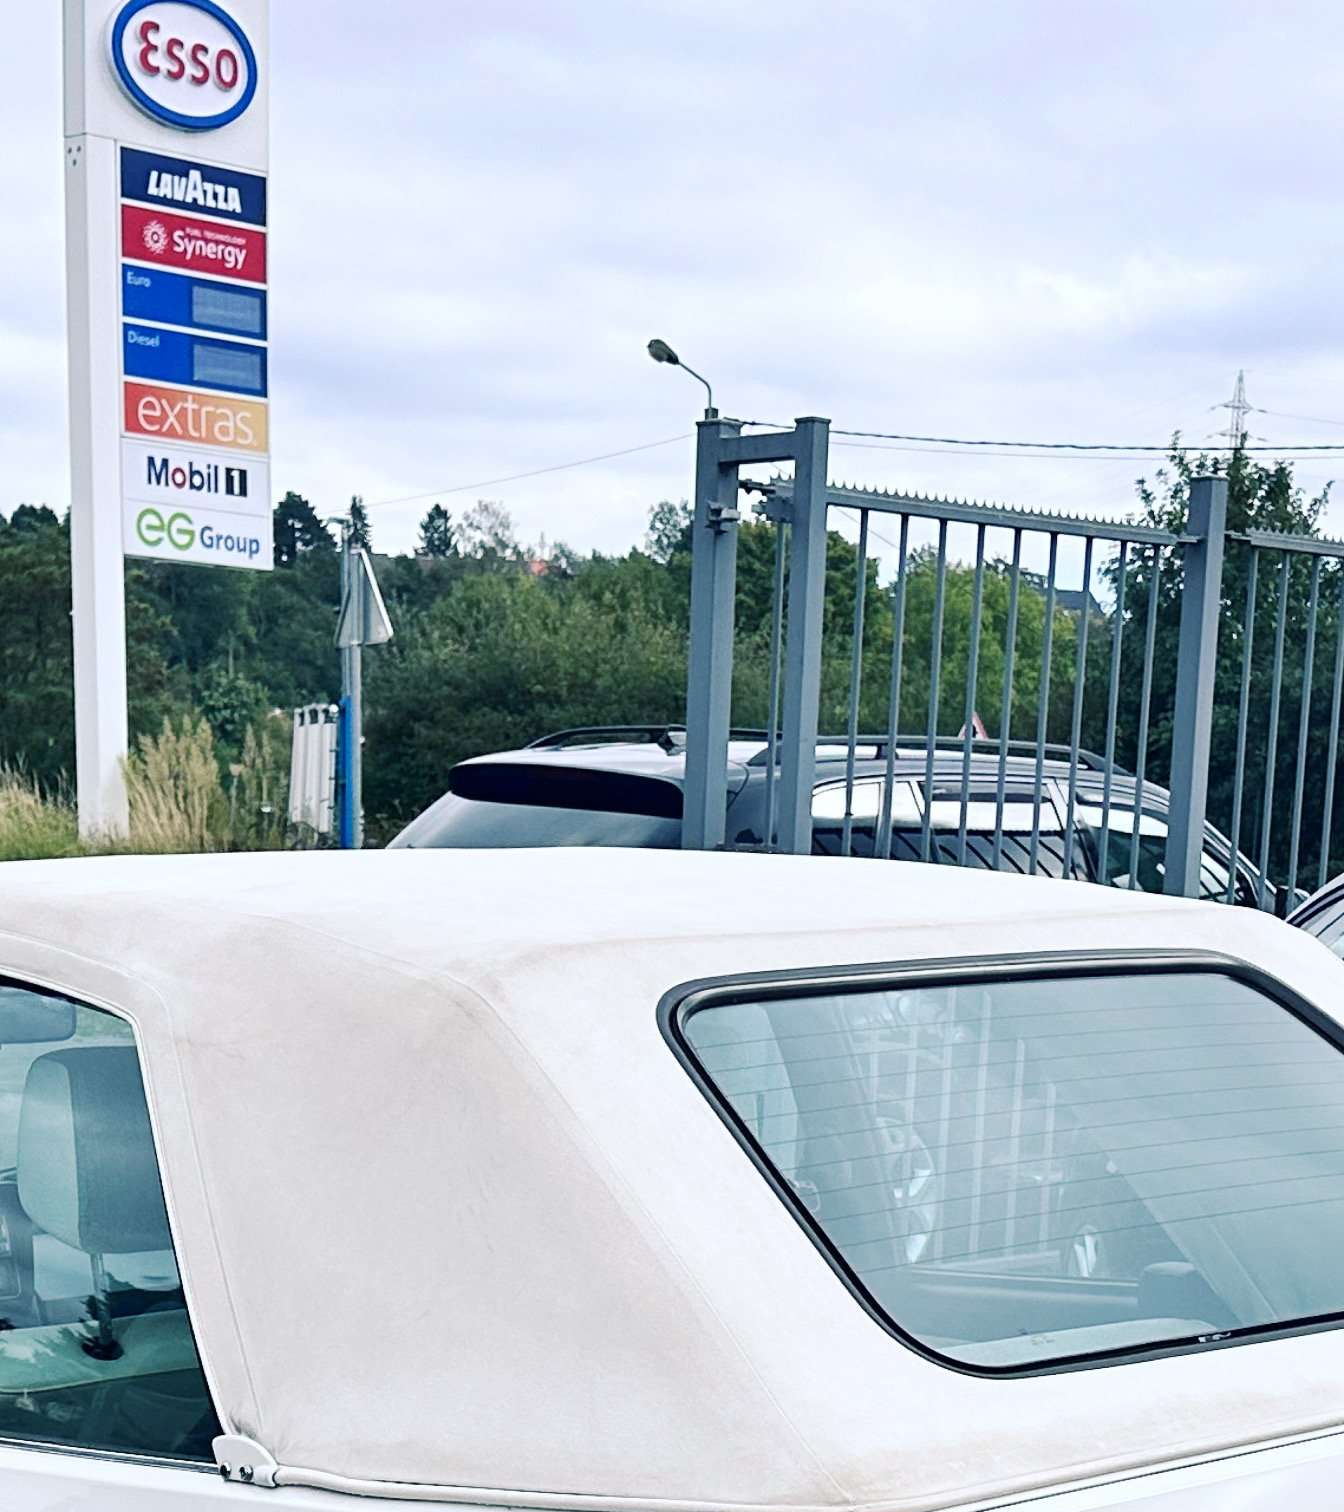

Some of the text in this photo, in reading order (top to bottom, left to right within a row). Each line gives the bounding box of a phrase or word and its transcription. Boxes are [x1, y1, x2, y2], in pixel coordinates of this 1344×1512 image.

[172, 230, 247, 270] Synergy
[127, 271, 152, 288] Euro
[127, 330, 160, 347] Diesel
[137, 394, 254, 446] extras
[147, 456, 245, 497] Mobil 1
[200, 526, 260, 559] Group
